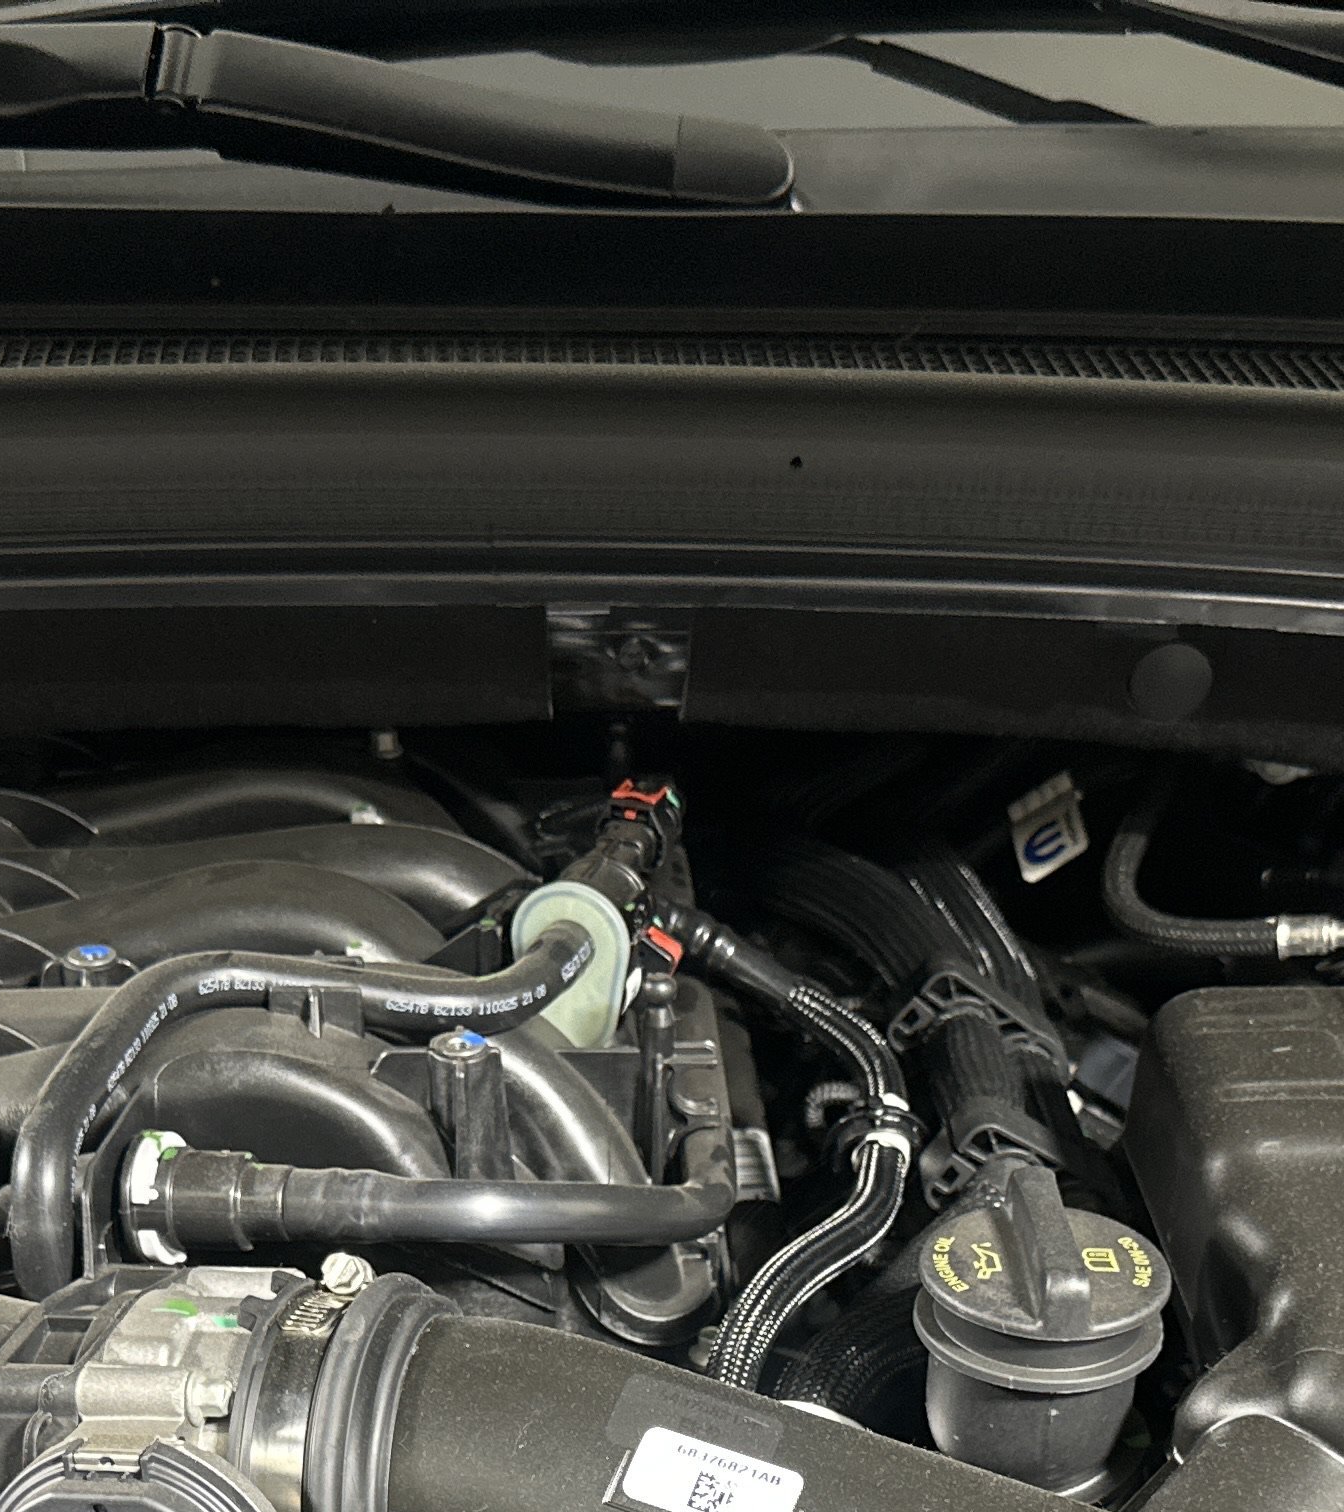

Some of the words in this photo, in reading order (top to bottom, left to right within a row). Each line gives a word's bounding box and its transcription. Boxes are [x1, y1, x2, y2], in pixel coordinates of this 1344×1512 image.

[933, 1236, 956, 1253] OIL
[932, 1253, 970, 1293] ENGINE
[1132, 1266, 1152, 1288] SAE
